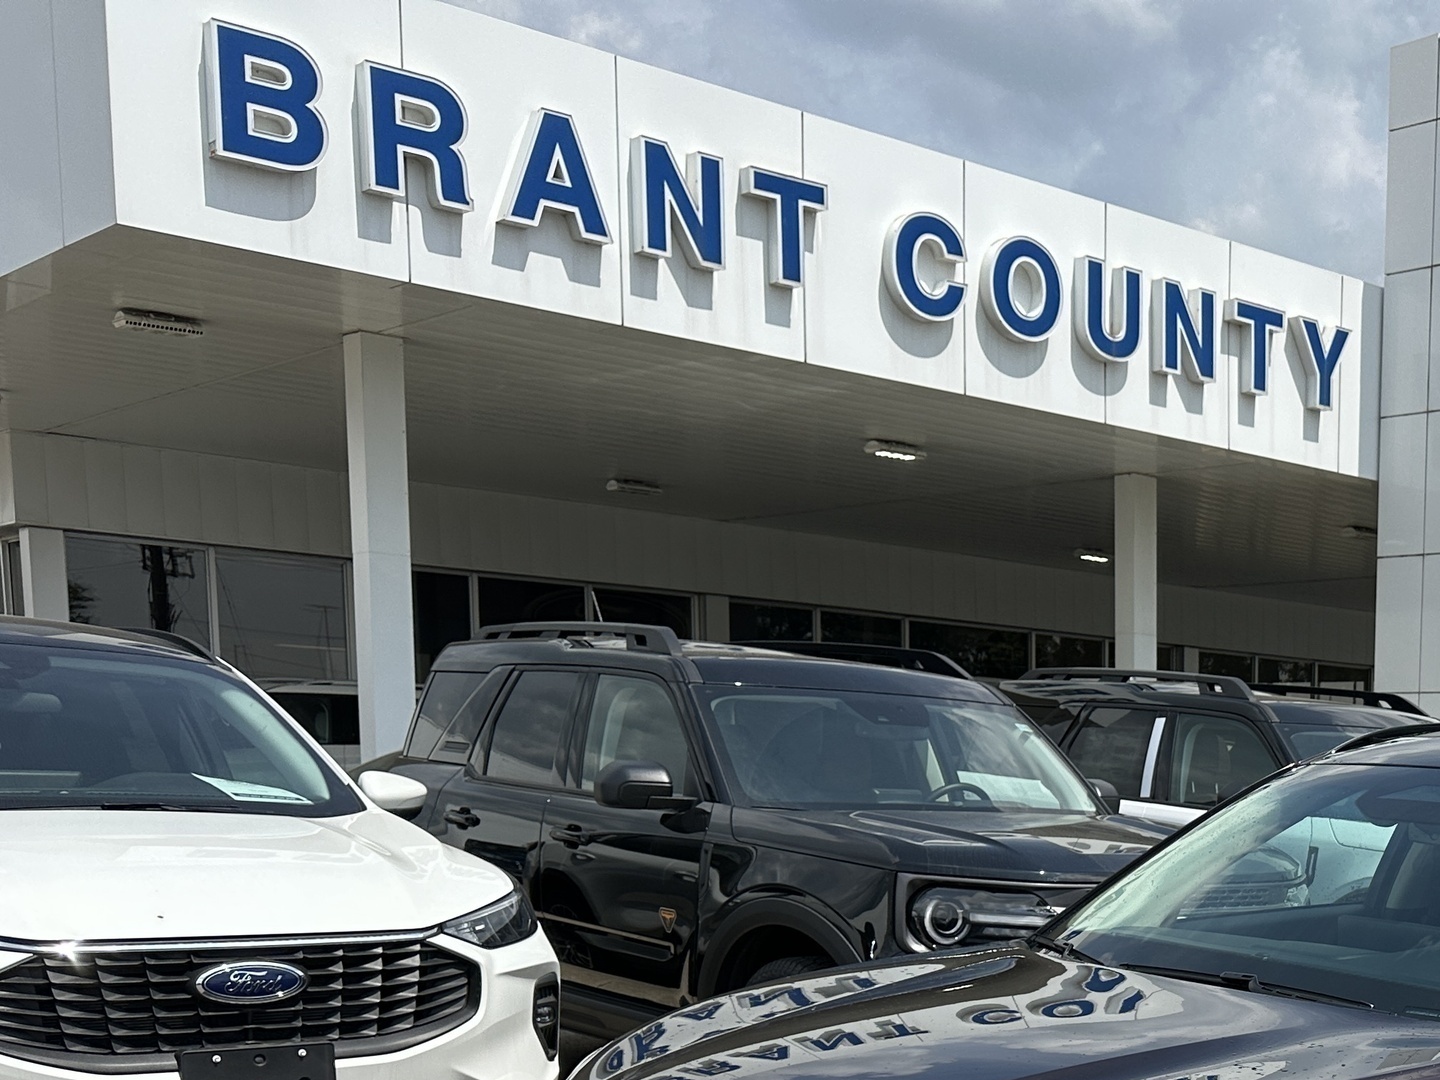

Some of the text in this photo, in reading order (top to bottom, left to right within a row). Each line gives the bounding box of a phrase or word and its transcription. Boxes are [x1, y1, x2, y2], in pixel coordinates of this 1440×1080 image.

[212, 18, 1350, 411] BRANT COUNTY
[224, 970, 284, 995] Ford
